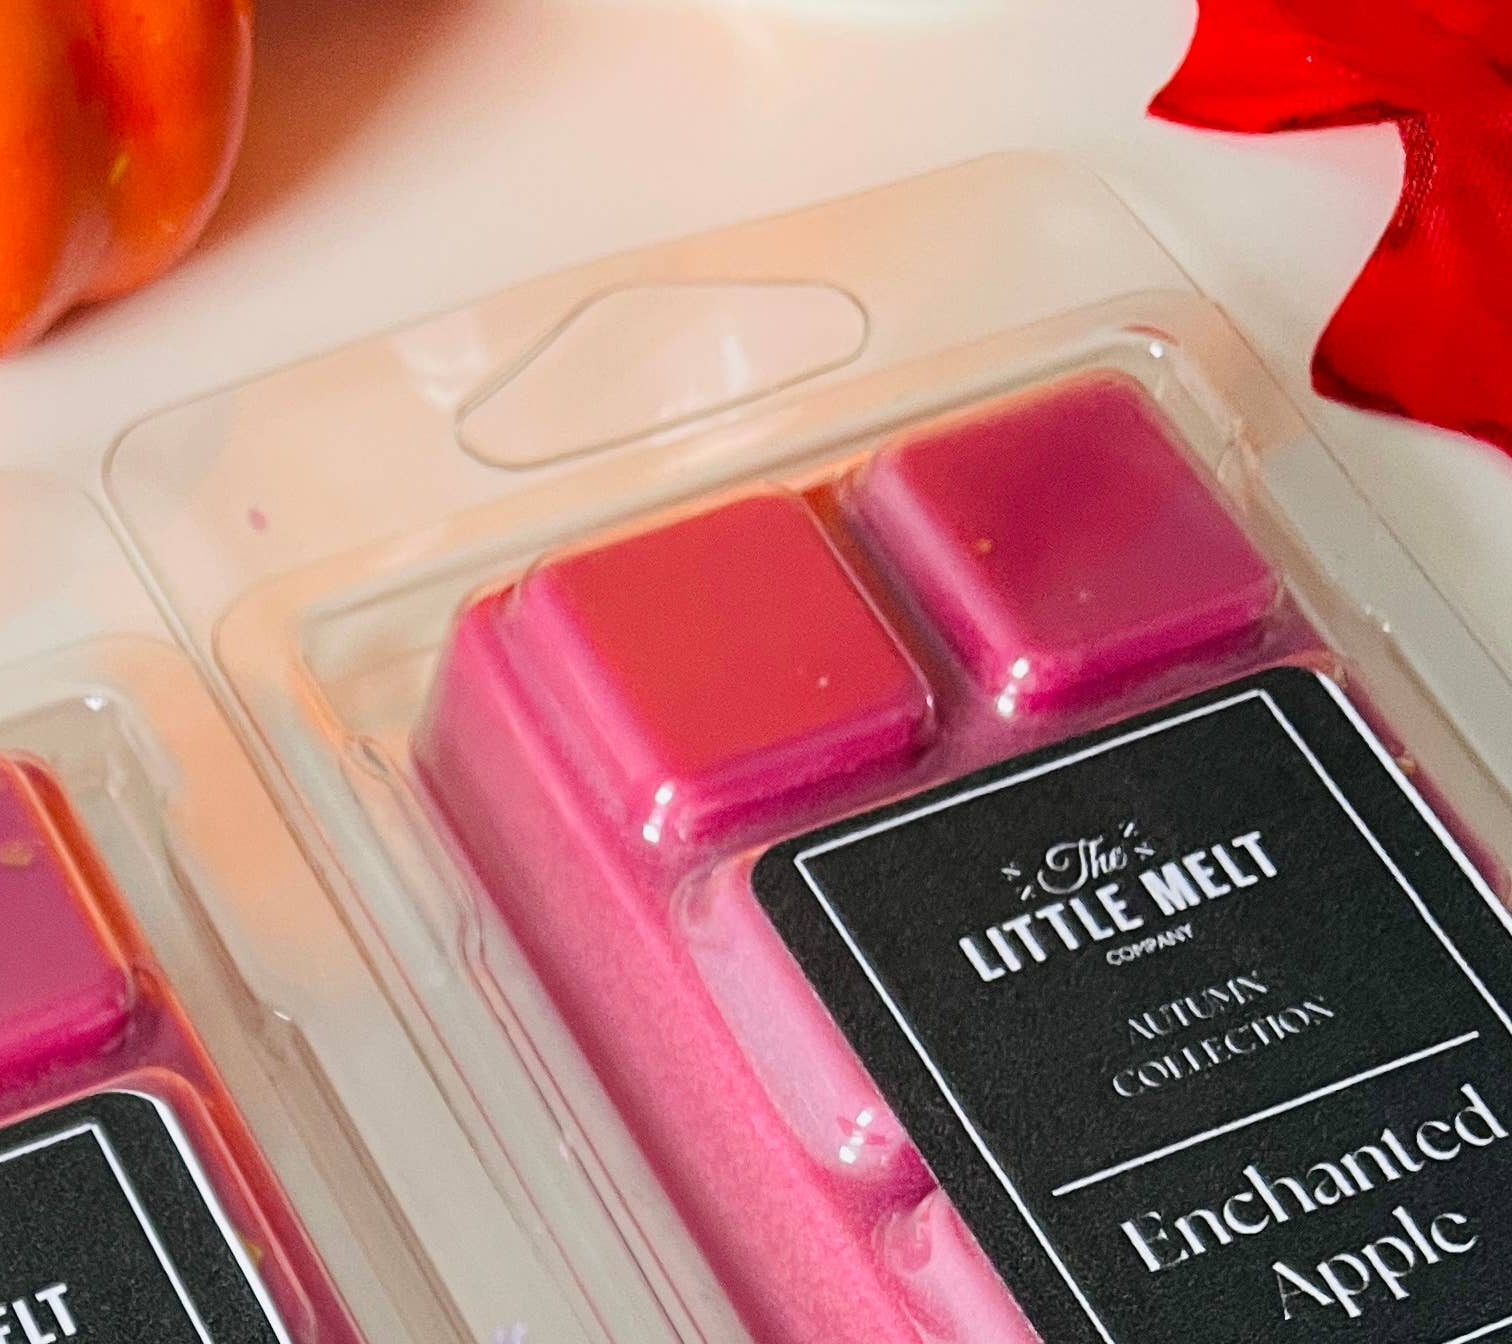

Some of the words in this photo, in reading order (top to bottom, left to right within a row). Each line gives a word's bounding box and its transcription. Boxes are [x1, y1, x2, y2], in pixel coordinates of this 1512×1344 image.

[959, 883, 1144, 982] LITTLE
[1139, 830, 1278, 917] MELT
[1037, 834, 1128, 894] The
[1106, 922, 1193, 965] COMPANY
[1112, 995, 1334, 1097] COLLECTION
[1128, 970, 1267, 1044] AUTUMN
[1121, 1083, 1509, 1272] Enchanted
[1272, 1206, 1478, 1320] Apple
